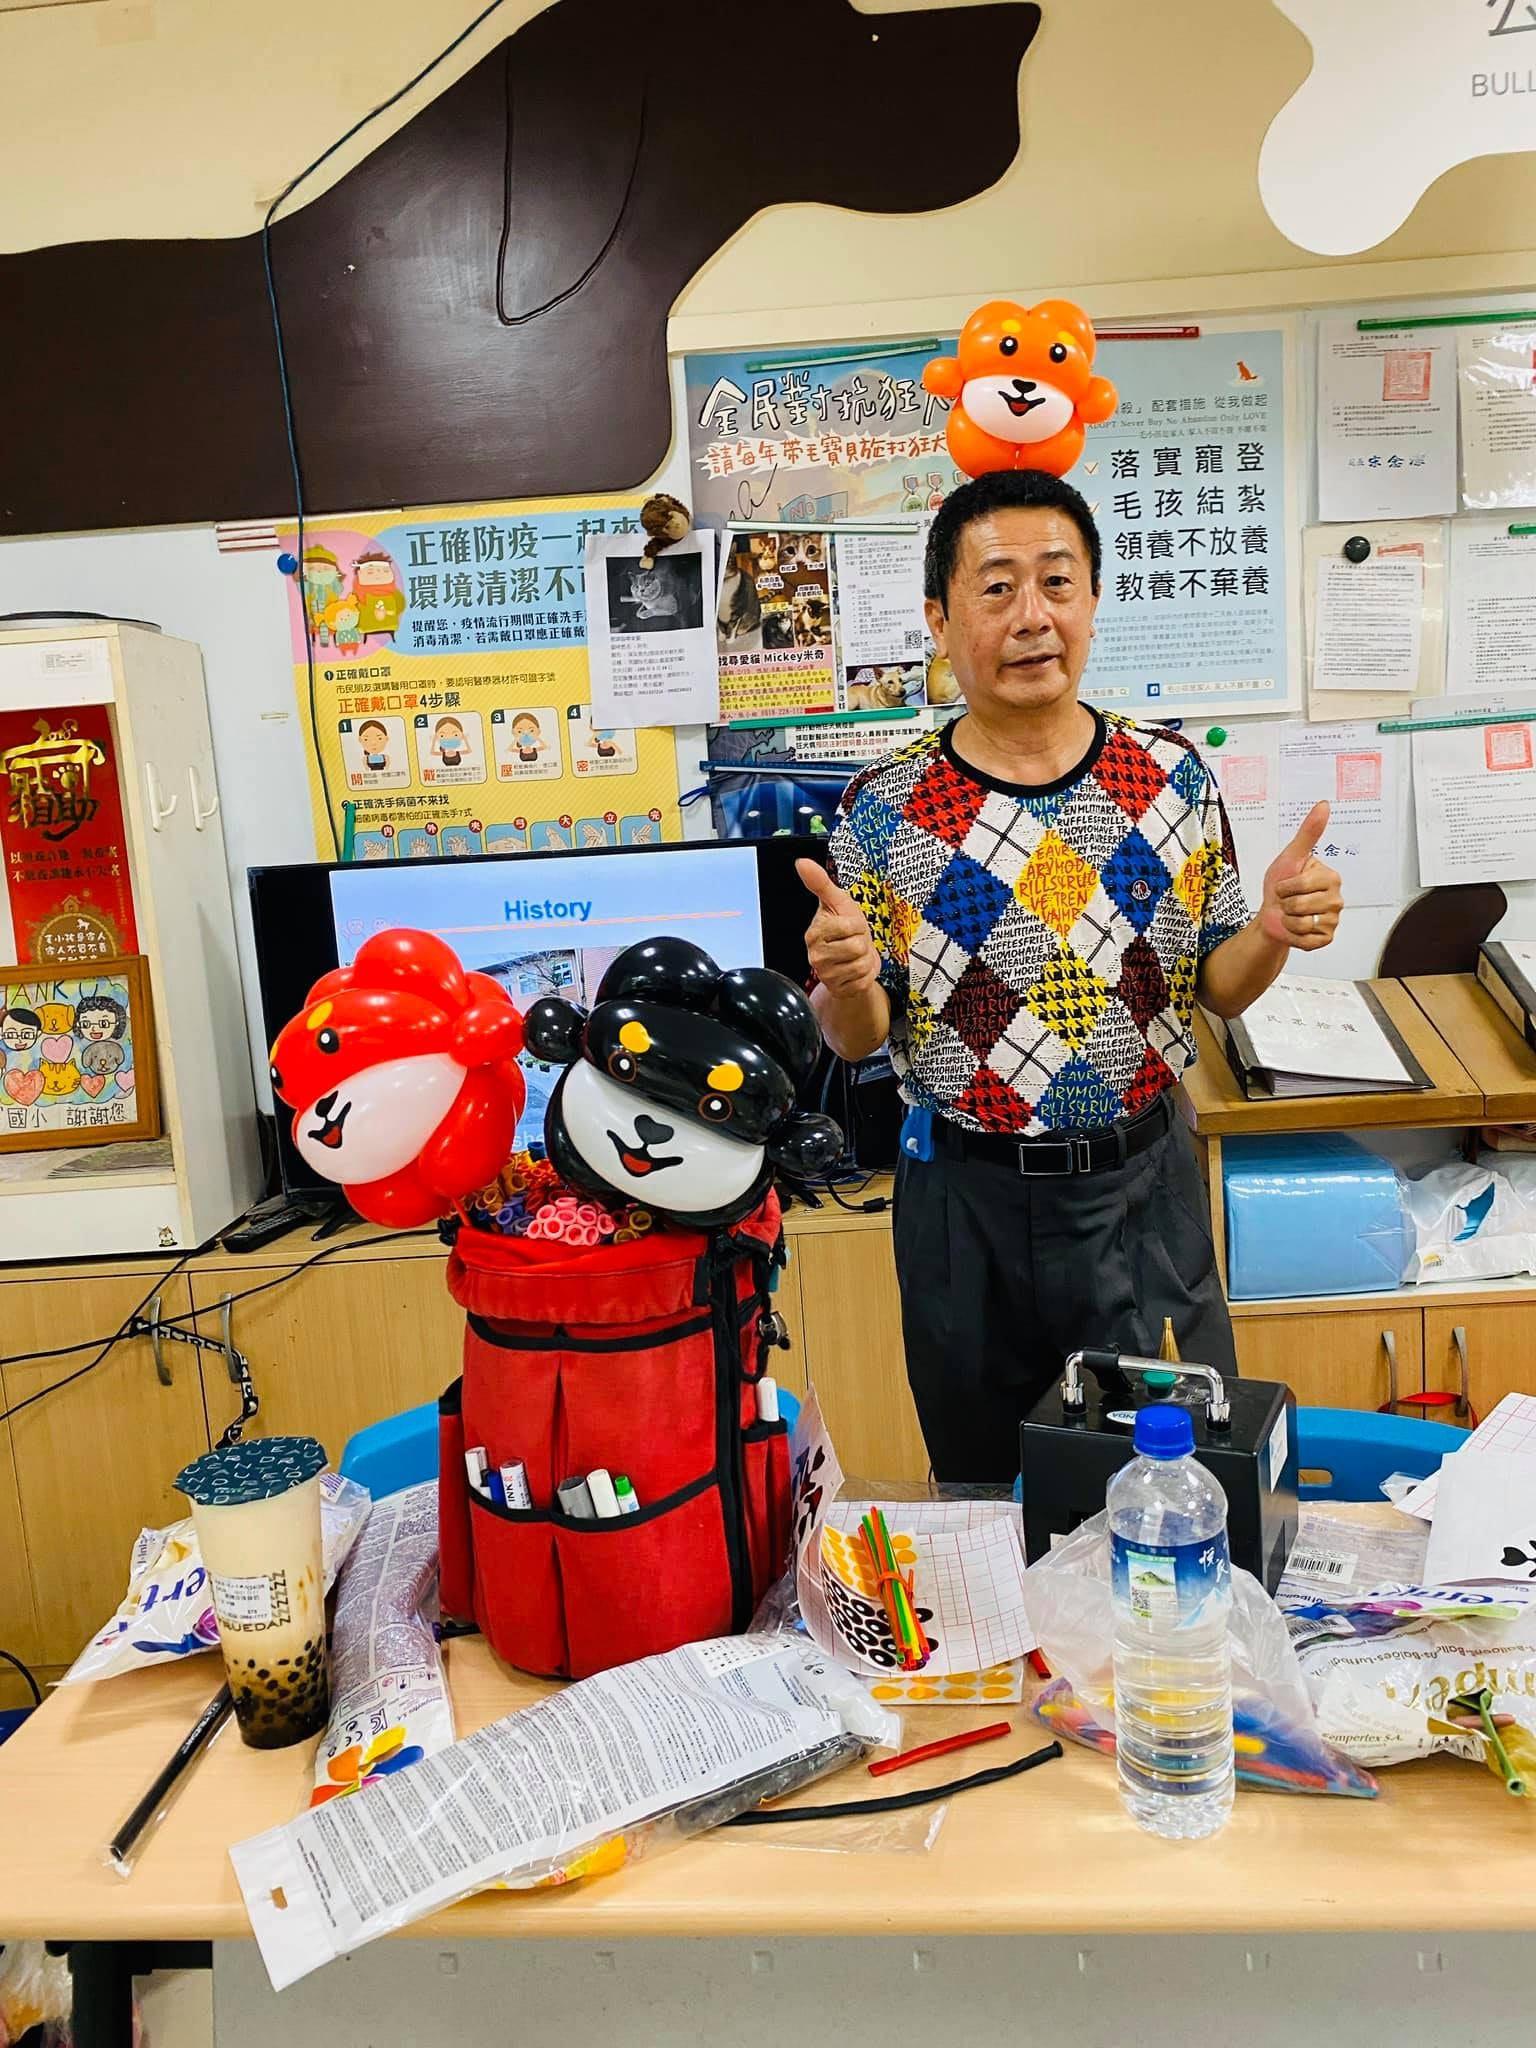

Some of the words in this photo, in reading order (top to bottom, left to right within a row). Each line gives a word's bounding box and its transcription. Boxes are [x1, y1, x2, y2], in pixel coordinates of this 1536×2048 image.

[1242, 411, 1268, 421] LOVE
[1111, 443, 1265, 480] 落實寵登
[1112, 484, 1266, 520] 毛孩結紮
[1114, 525, 1269, 561] 領養不放養
[409, 566, 585, 610] 環境清潔不
[1115, 566, 1269, 602] 教養不棄養
[763, 649, 825, 665] Mickey米奇
[494, 712, 502, 722] 3
[571, 709, 578, 718] 4
[341, 722, 348, 732] 1
[416, 717, 425, 727] 2
[560, 815, 572, 827] 大
[606, 813, 616, 824] 立
[504, 899, 592, 922] History
[8, 1106, 48, 1128] 國小
[66, 1103, 128, 1126] 謝謝您
